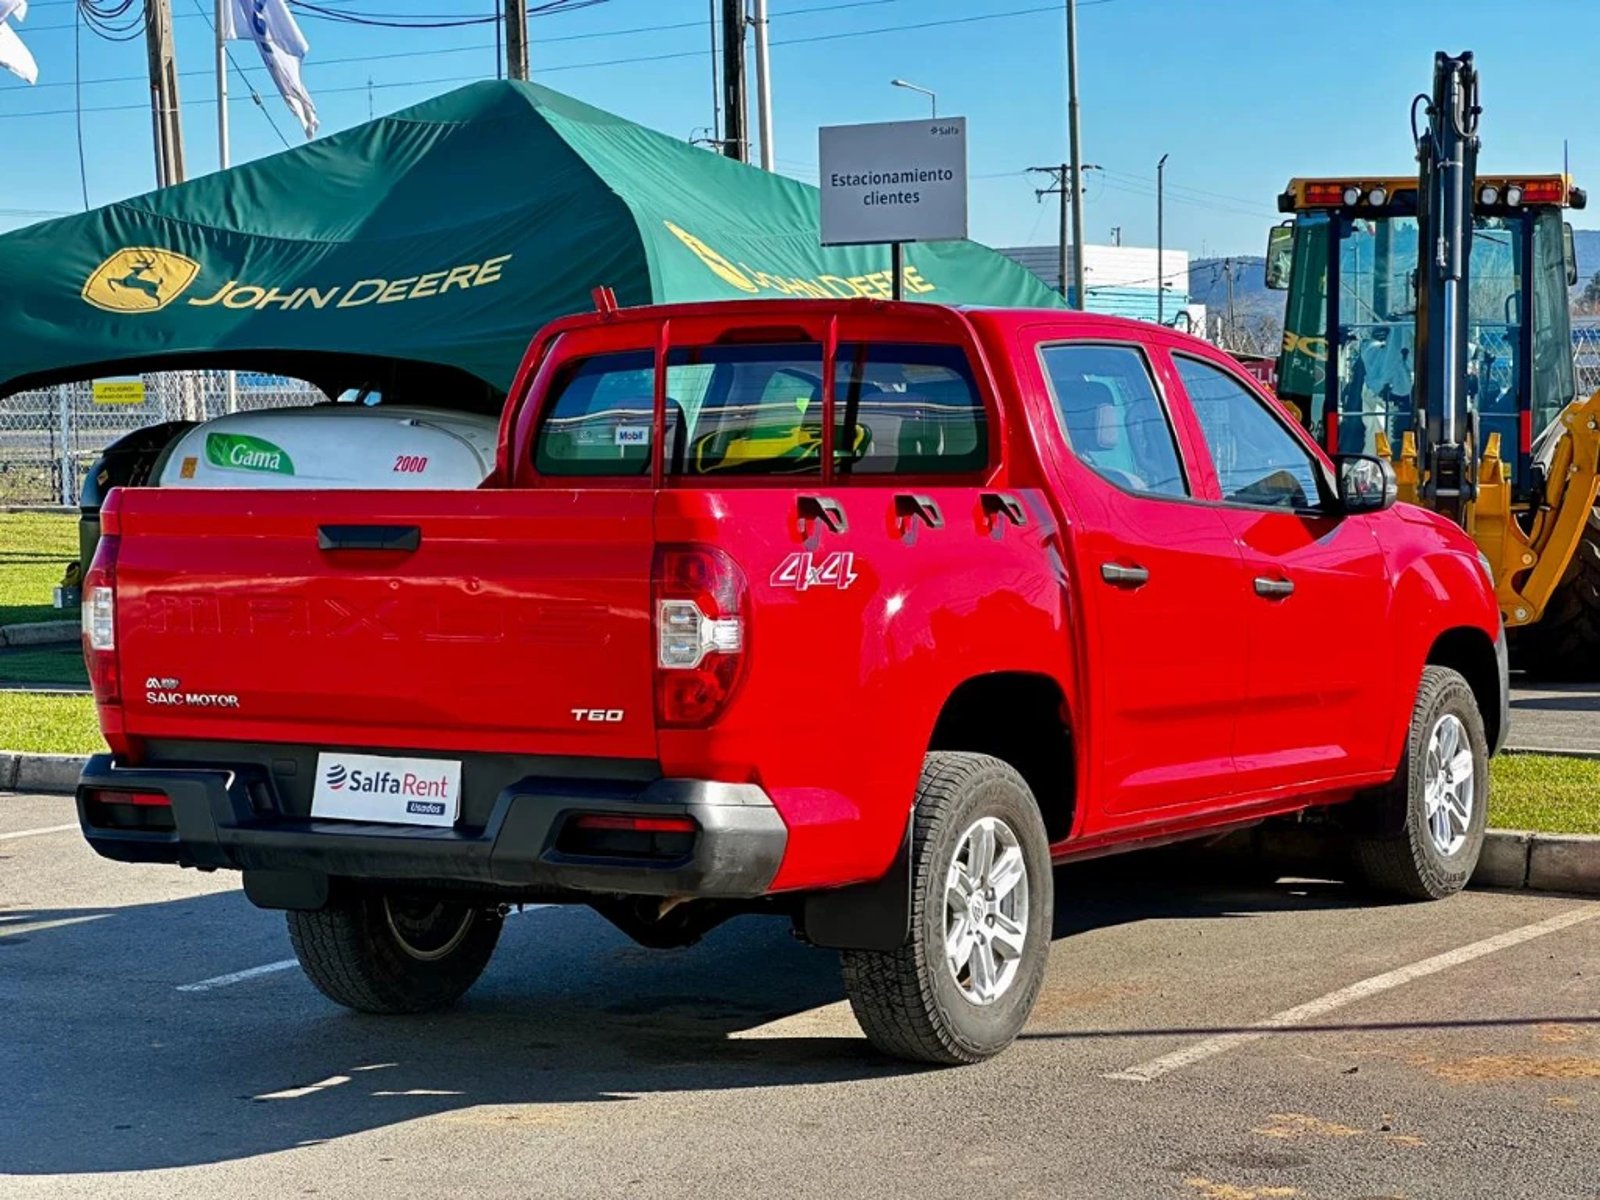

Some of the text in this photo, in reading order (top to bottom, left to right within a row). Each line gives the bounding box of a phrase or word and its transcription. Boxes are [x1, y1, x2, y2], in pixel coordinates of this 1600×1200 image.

[831, 168, 953, 187] Estacionamiento
[863, 190, 920, 206] clientes
[188, 254, 513, 310] JOHN DEERE
[619, 430, 644, 441] Mobil
[230, 443, 281, 470] Gama
[393, 455, 428, 474] 2000
[769, 551, 859, 592] 4x4
[145, 691, 240, 708] SAIC MOTOR
[571, 708, 625, 722] T60
[349, 769, 449, 799] SalfaRent
[410, 803, 441, 814] Usados
